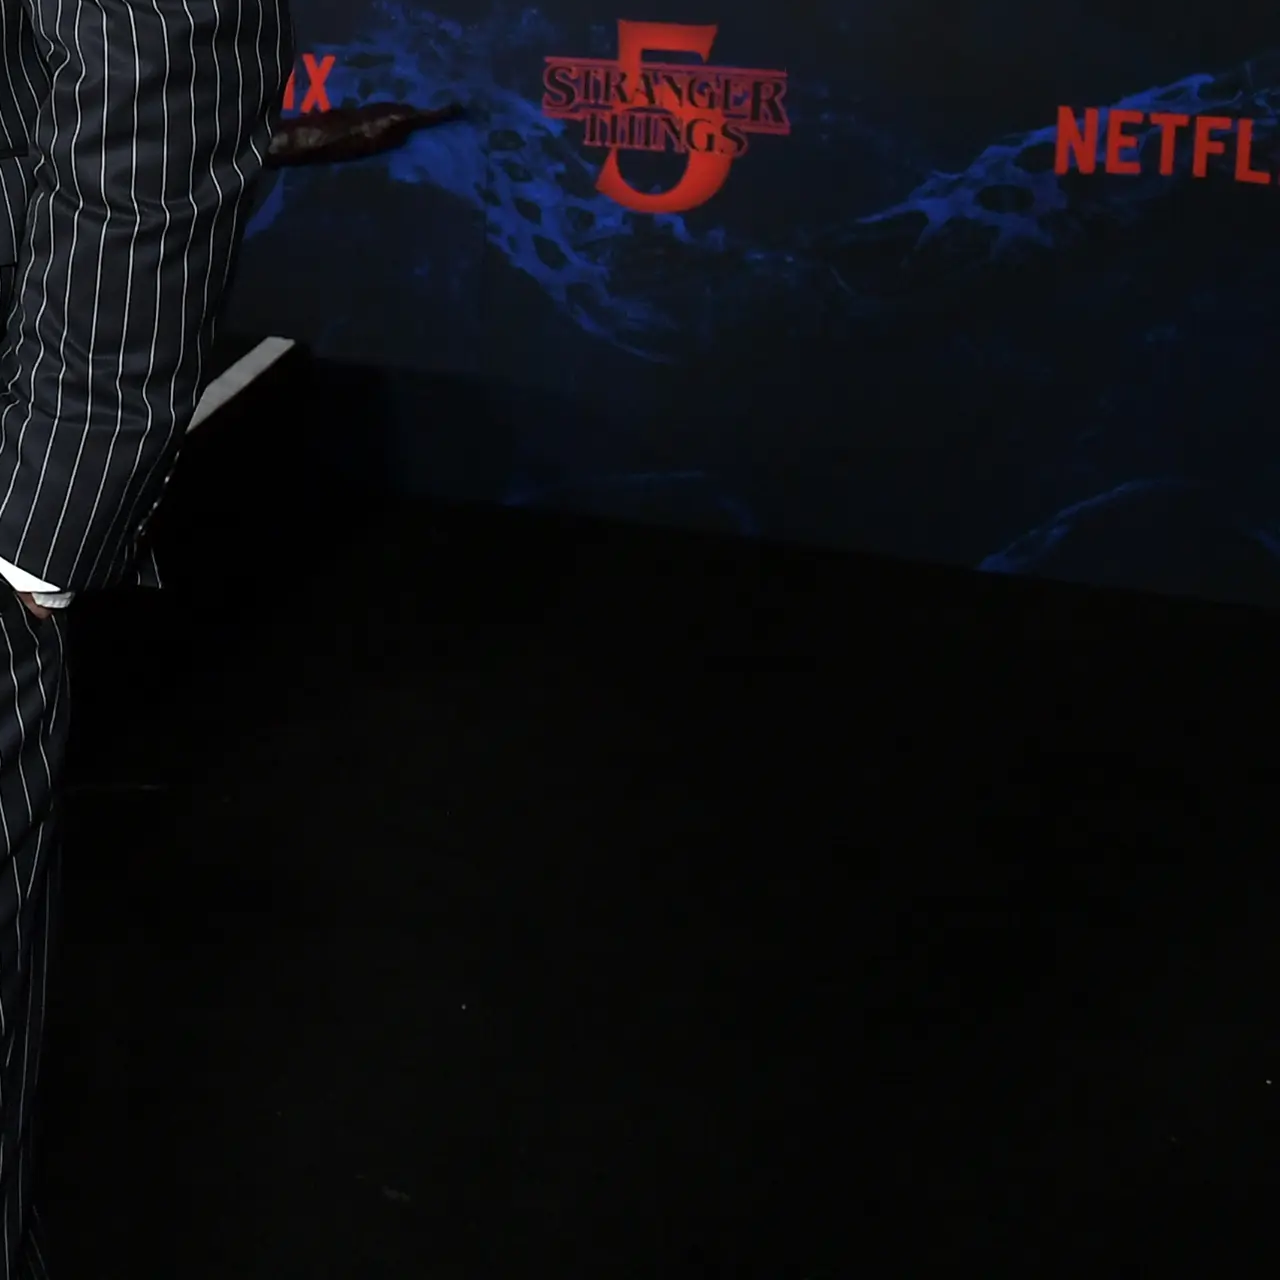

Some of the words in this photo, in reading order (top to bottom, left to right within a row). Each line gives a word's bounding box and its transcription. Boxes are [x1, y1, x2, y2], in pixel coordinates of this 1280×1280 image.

[543, 65, 790, 127] STRANGER
[595, 19, 732, 214] 5
[583, 109, 749, 158] THINGS
[1054, 104, 1280, 185] NETFL
